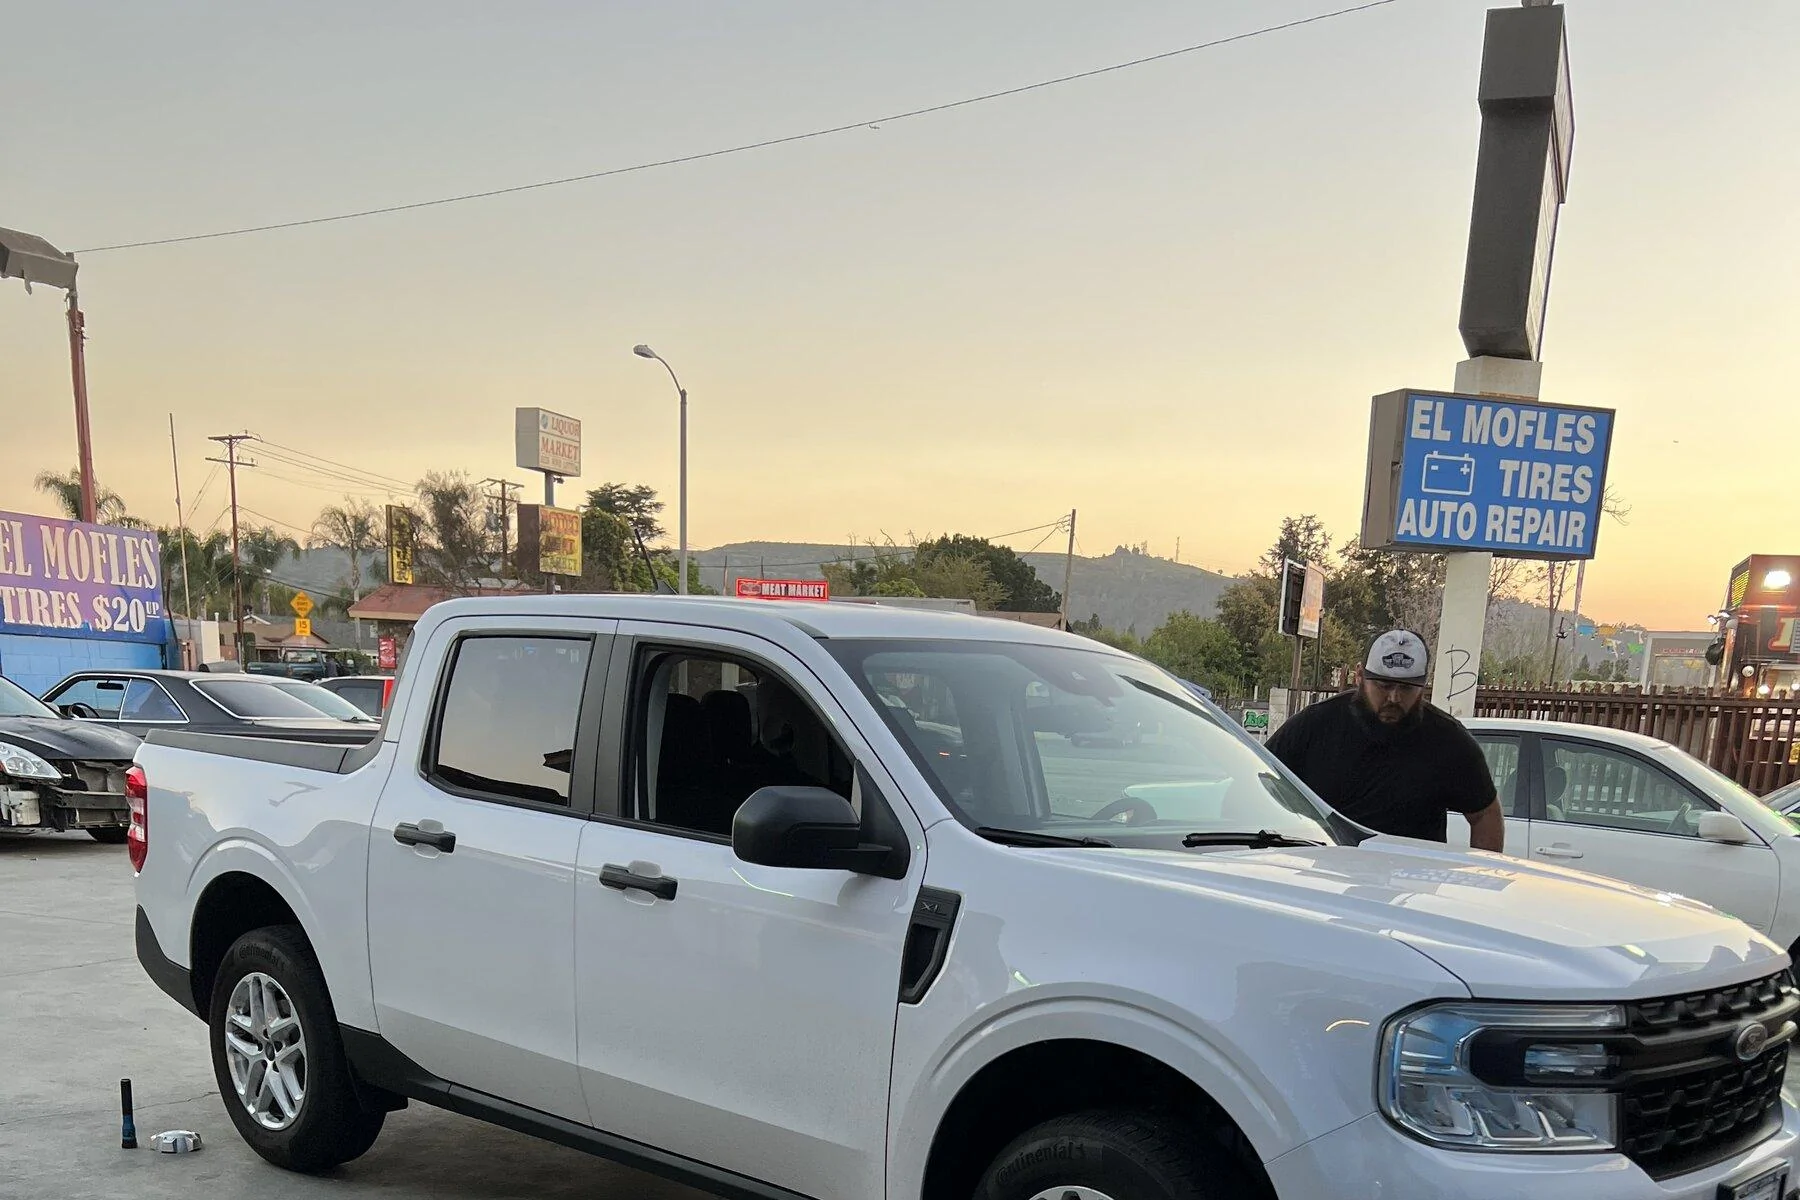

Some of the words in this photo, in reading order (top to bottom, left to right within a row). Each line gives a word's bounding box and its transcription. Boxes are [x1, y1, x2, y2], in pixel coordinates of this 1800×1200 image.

[541, 436, 579, 461] MARKET
[1410, 400, 1451, 442] EL
[1462, 404, 1597, 455] MOFLES
[1499, 459, 1594, 504] TIRES
[1396, 498, 1477, 541] AUTO
[1484, 504, 1587, 548] REPAIR
[0, 519, 32, 577] EL
[40, 525, 157, 590] MOFLES
[0, 586, 83, 629] TIRES
[92, 595, 146, 633] $20
[146, 601, 160, 615] UP
[761, 583, 787, 596] MEAT
[788, 584, 825, 598] MARKET
